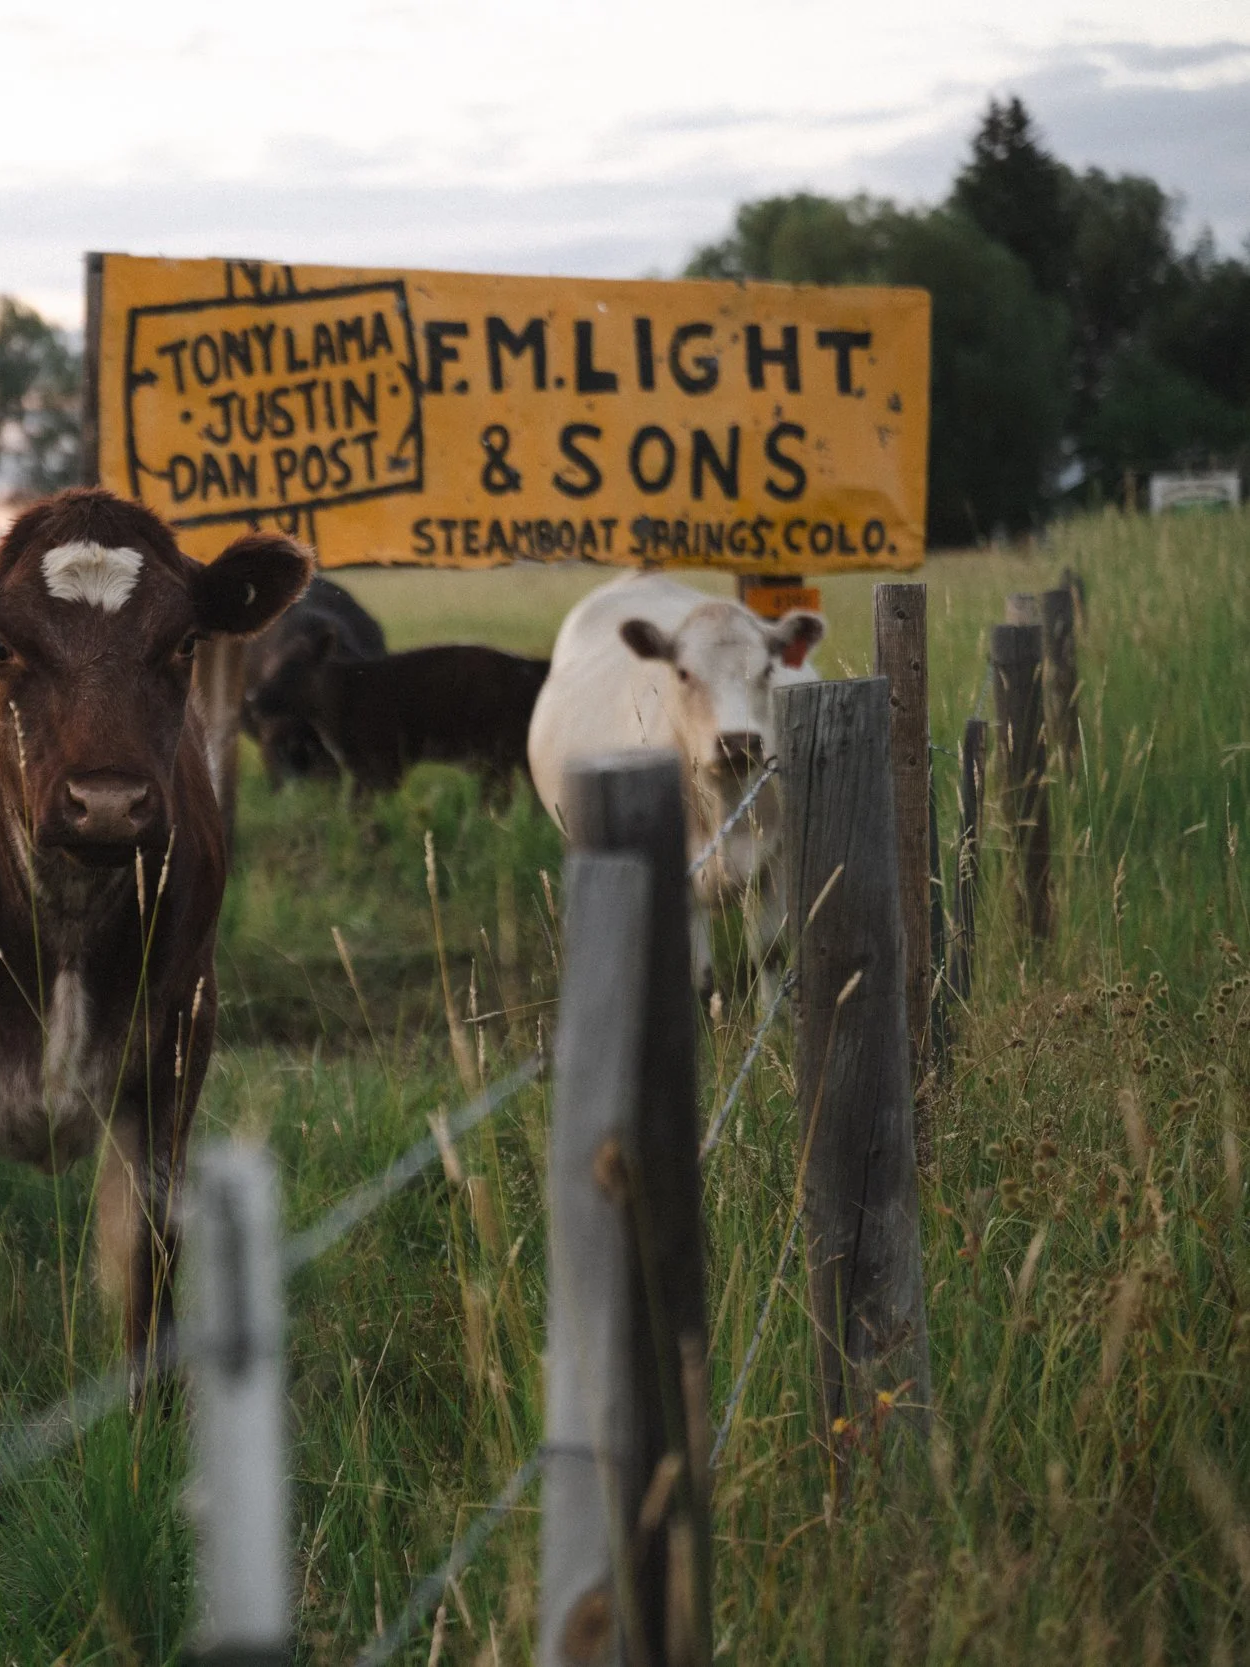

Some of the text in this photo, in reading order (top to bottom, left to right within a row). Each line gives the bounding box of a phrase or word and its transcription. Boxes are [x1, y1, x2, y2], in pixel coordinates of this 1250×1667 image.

[156, 311, 393, 394] TONY LAMA
[202, 371, 377, 446] JUSTIN
[167, 431, 378, 503] DAN POST
[481, 420, 808, 500] & SONS
[411, 516, 618, 557] STEAMBOAT
[782, 518, 897, 557] COLO.
